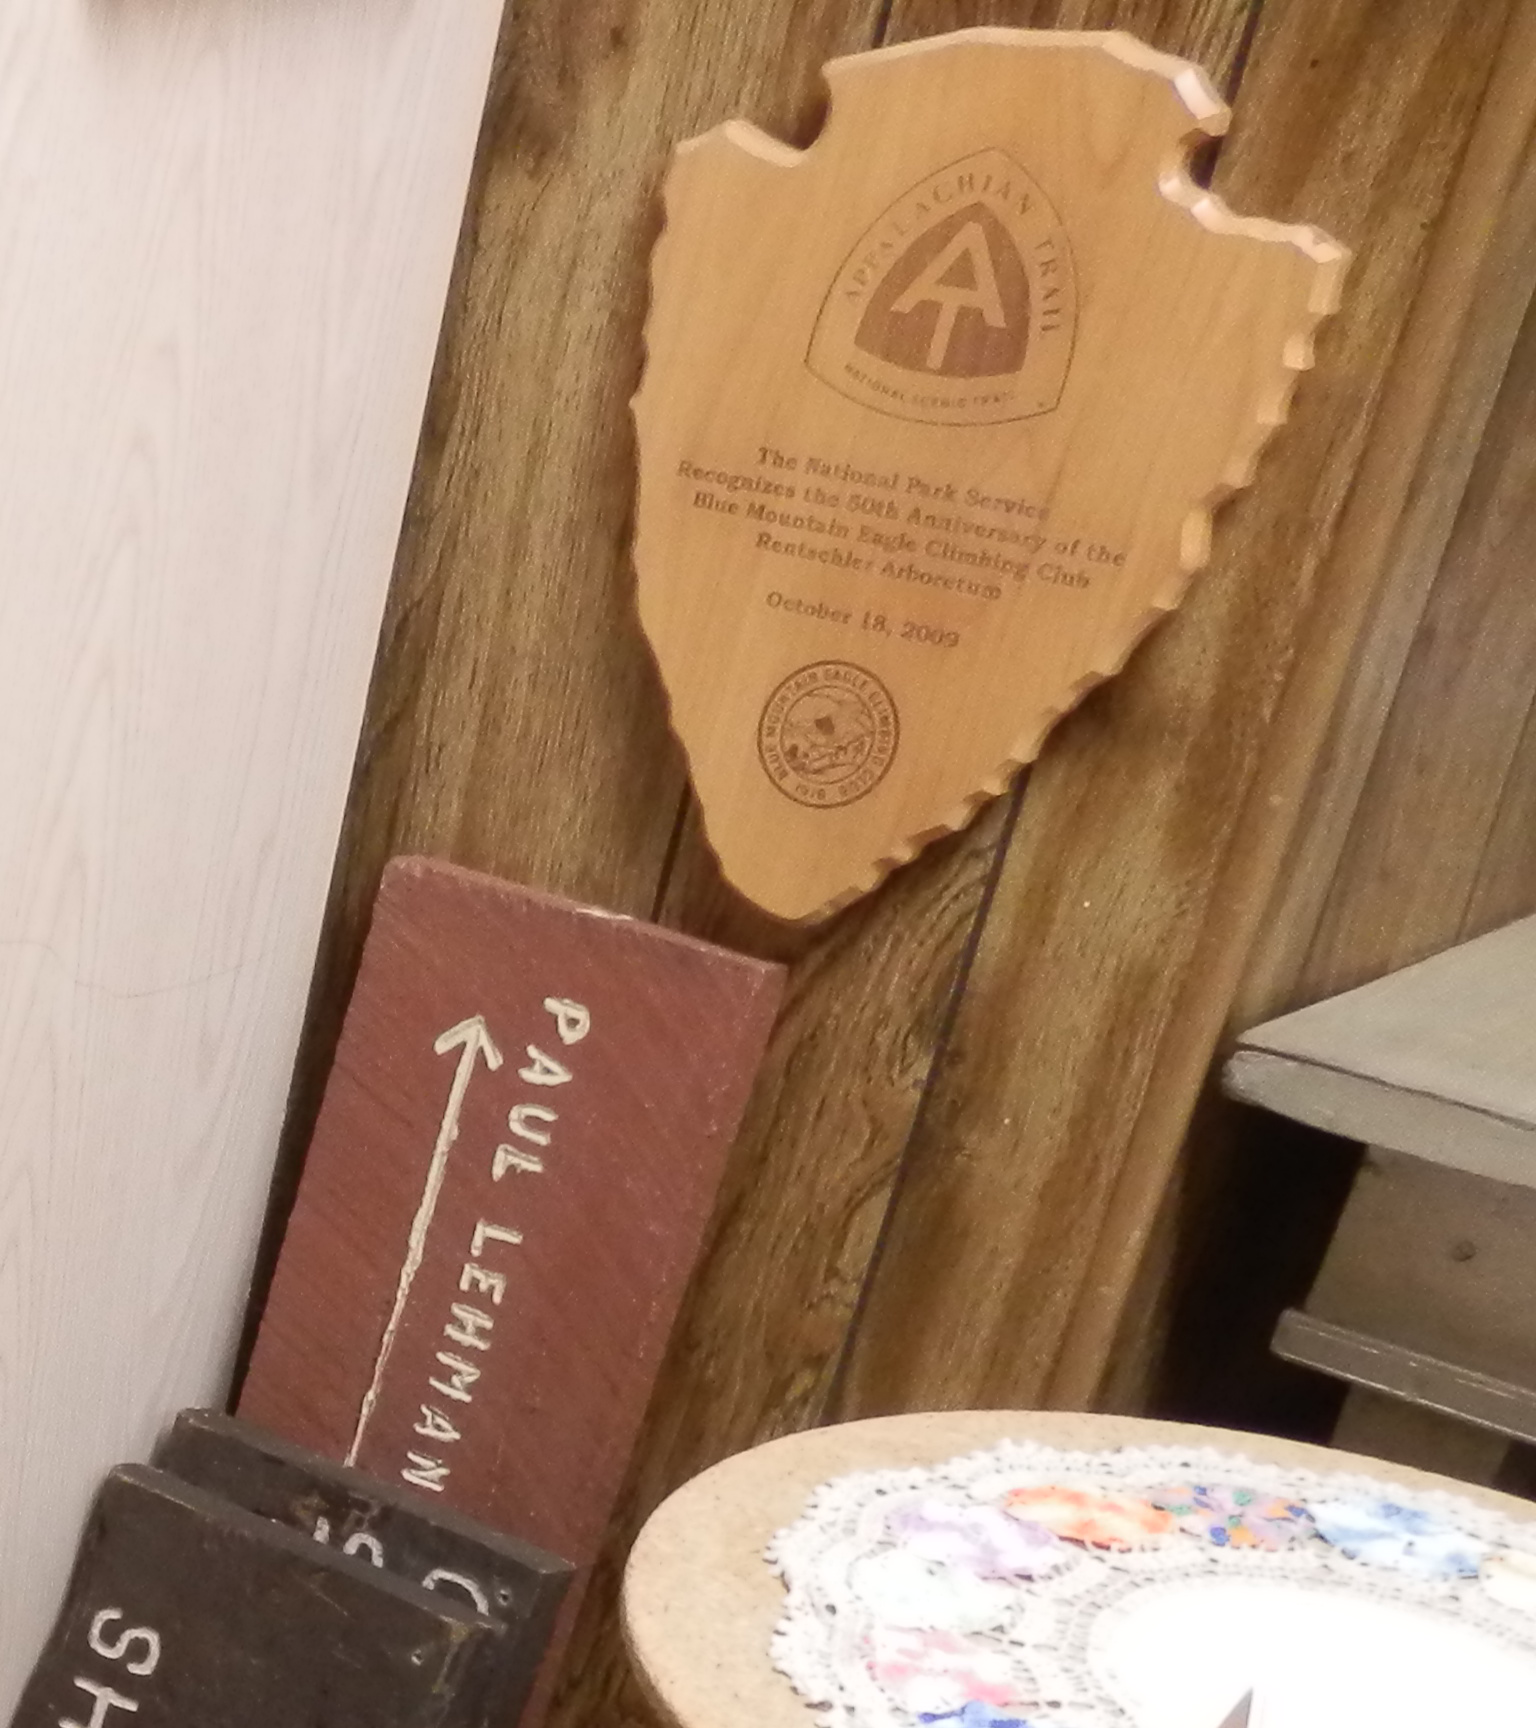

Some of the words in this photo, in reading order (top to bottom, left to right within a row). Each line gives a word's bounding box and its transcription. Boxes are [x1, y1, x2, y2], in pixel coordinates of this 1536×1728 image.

[843, 170, 1034, 300] APPALACHIAN
[1034, 237, 1064, 334] TRAIL
[675, 459, 797, 500] Recognizes
[803, 484, 841, 508] the
[845, 492, 901, 521] 50th
[905, 505, 1048, 555] Anniversary
[1053, 537, 1083, 559] of
[1086, 544, 1128, 569] the
[757, 445, 798, 472] The
[804, 456, 900, 492] National
[904, 473, 959, 503] Park
[965, 486, 1052, 521] Service
[692, 491, 740, 516] Blue
[745, 502, 851, 541] Mountain
[855, 523, 918, 556] Eagle
[924, 537, 1031, 583] Climbing
[1036, 560, 1092, 591] Club
[754, 530, 875, 574] Rentschler
[880, 560, 1004, 602] Arboretum
[764, 590, 853, 627] October
[860, 609, 894, 638] 18,
[900, 620, 962, 650] 2009
[490, 996, 592, 1183] PAUL
[400, 1219, 525, 1494] LEHMAN
